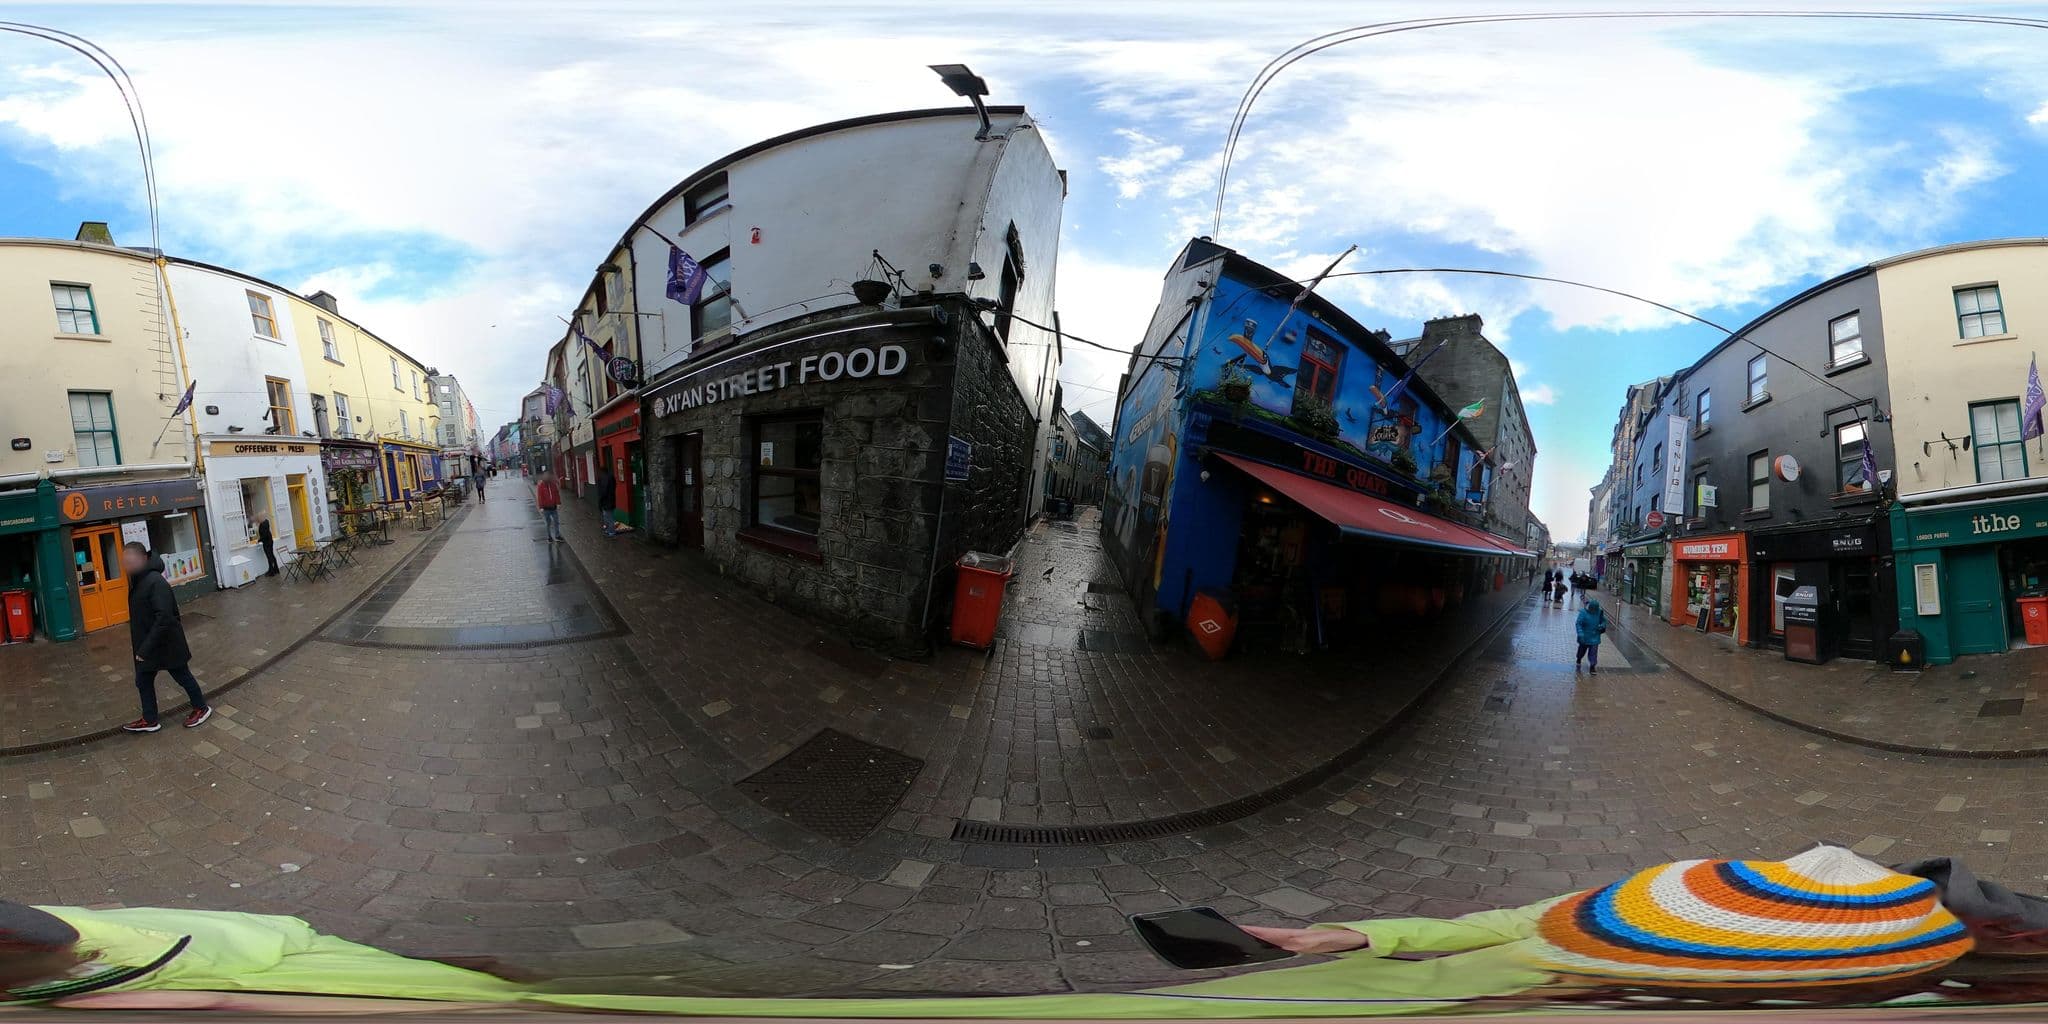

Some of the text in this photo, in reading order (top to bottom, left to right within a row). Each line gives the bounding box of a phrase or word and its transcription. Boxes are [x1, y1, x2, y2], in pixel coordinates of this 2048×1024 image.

[666, 345, 907, 413] XI'AN STREET FOOD
[234, 444, 305, 453] COFFEEWERK PRESS
[1303, 450, 1389, 495] THE QUAYS
[1671, 439, 1682, 486] SNUG
[1972, 513, 2021, 534] ithe
[1682, 543, 1728, 554] NUMBER TEN
[1832, 538, 1862, 547] SNUG
